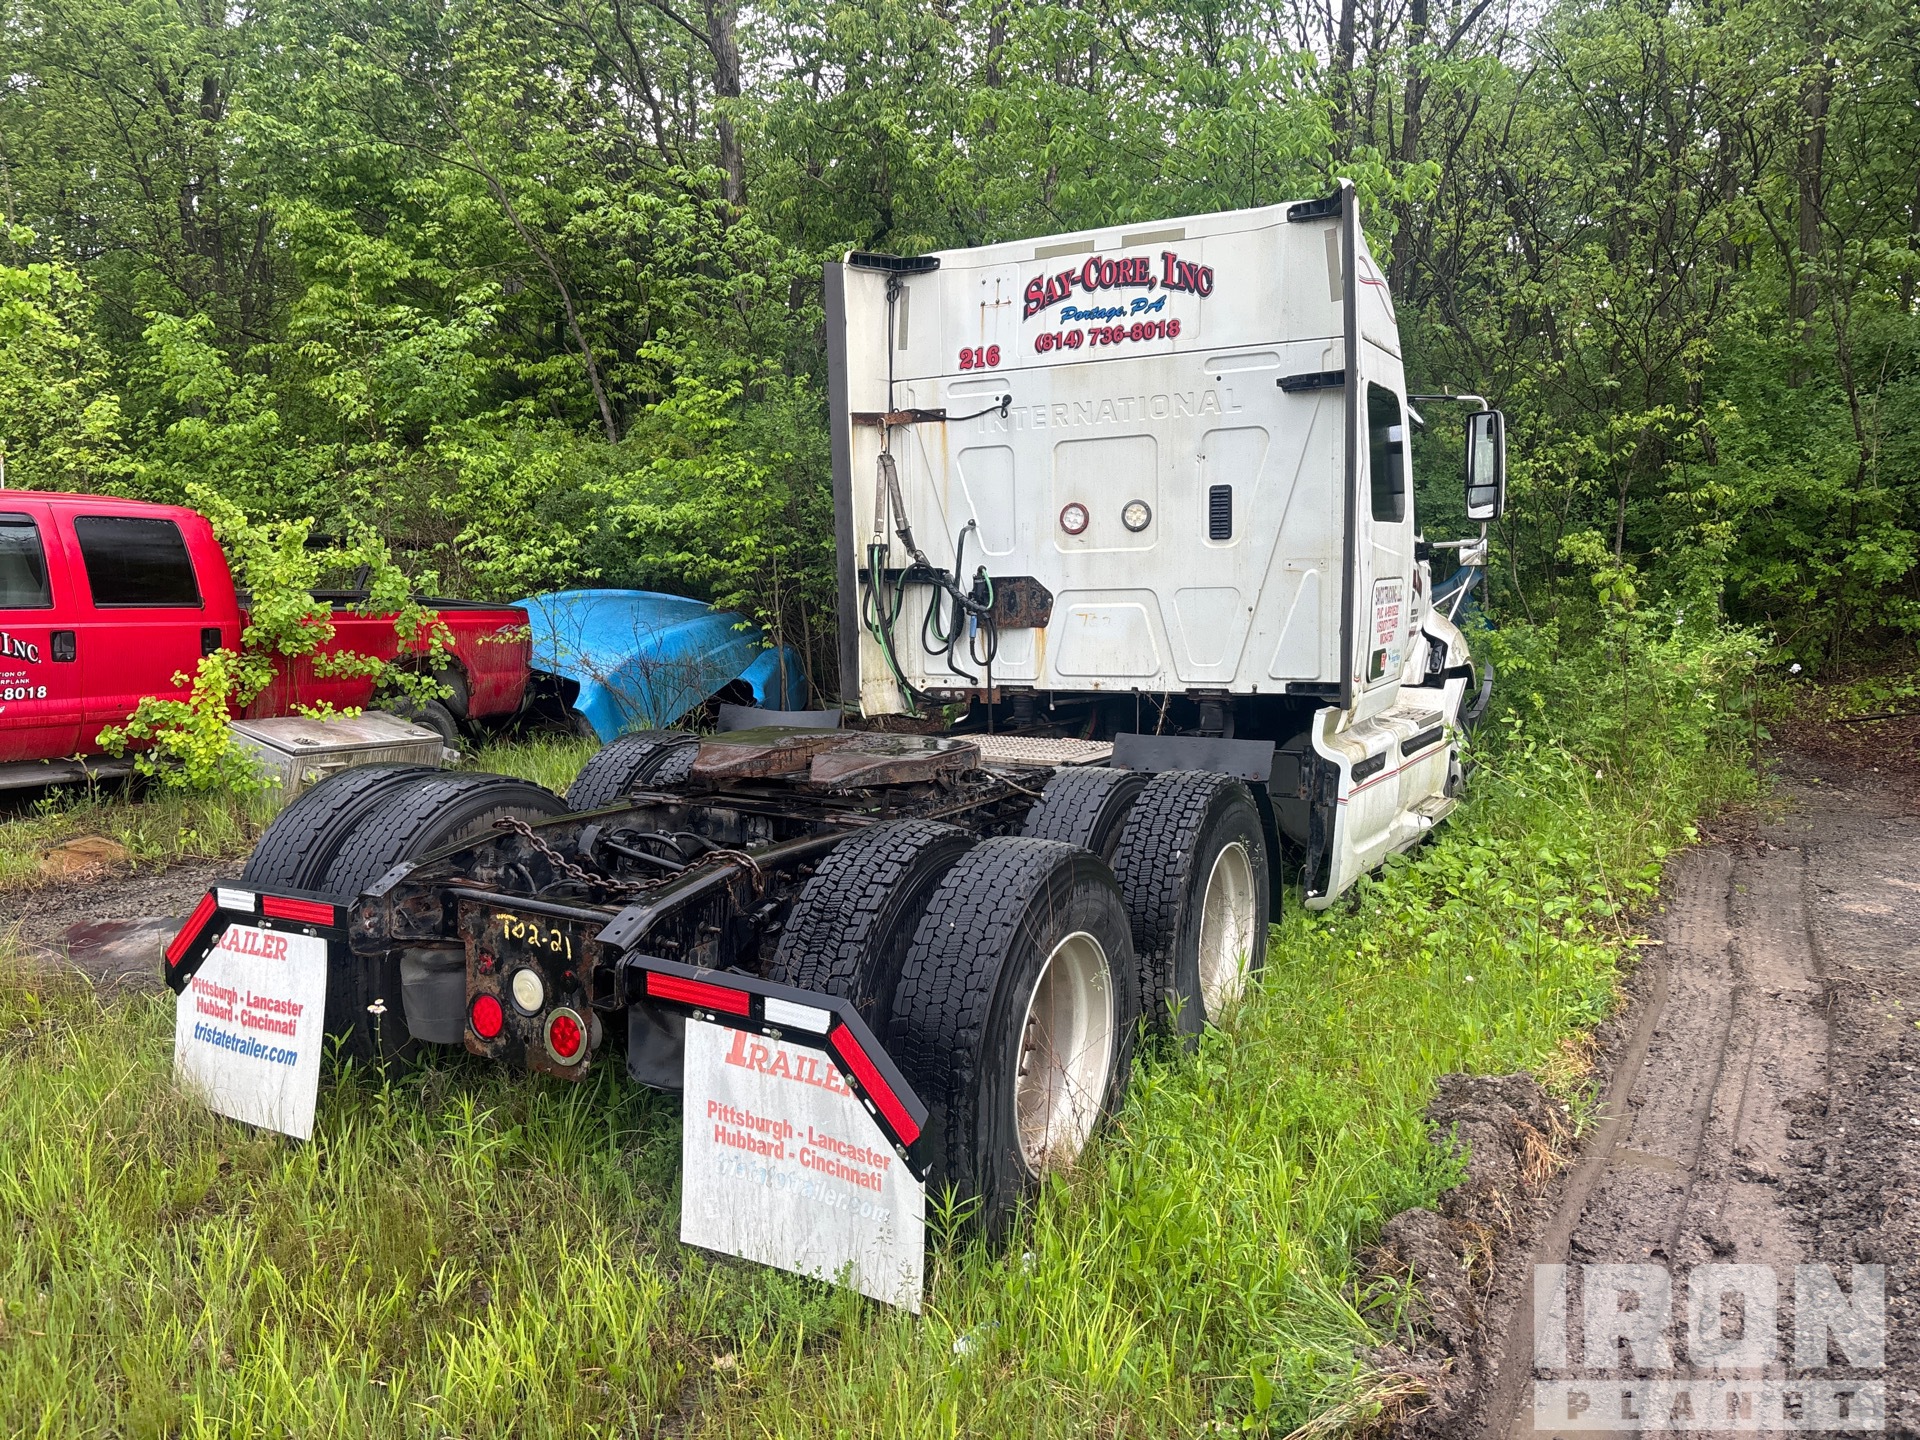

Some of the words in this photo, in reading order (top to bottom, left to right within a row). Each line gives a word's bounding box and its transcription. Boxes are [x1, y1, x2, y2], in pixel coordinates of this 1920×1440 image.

[1162, 251, 1214, 298] INC
[1131, 295, 1167, 313] PA
[1035, 329, 1084, 353] (814)
[1089, 319, 1181, 346] 736-8018
[959, 345, 1000, 370] 216
[978, 389, 1242, 433] INTERNATIONAL
[191, 977, 238, 1004] Pittsburgh
[246, 990, 304, 1018] Lancaster
[196, 998, 233, 1022] Hubbard
[241, 1009, 297, 1036] Cincinnati
[194, 1022, 298, 1067] tristatetrailer.com
[707, 1100, 793, 1139] Pittsburgh
[808, 1126, 891, 1171] Lancaster
[714, 1124, 784, 1160] Hubbard
[799, 1147, 882, 1193] Cincinnati
